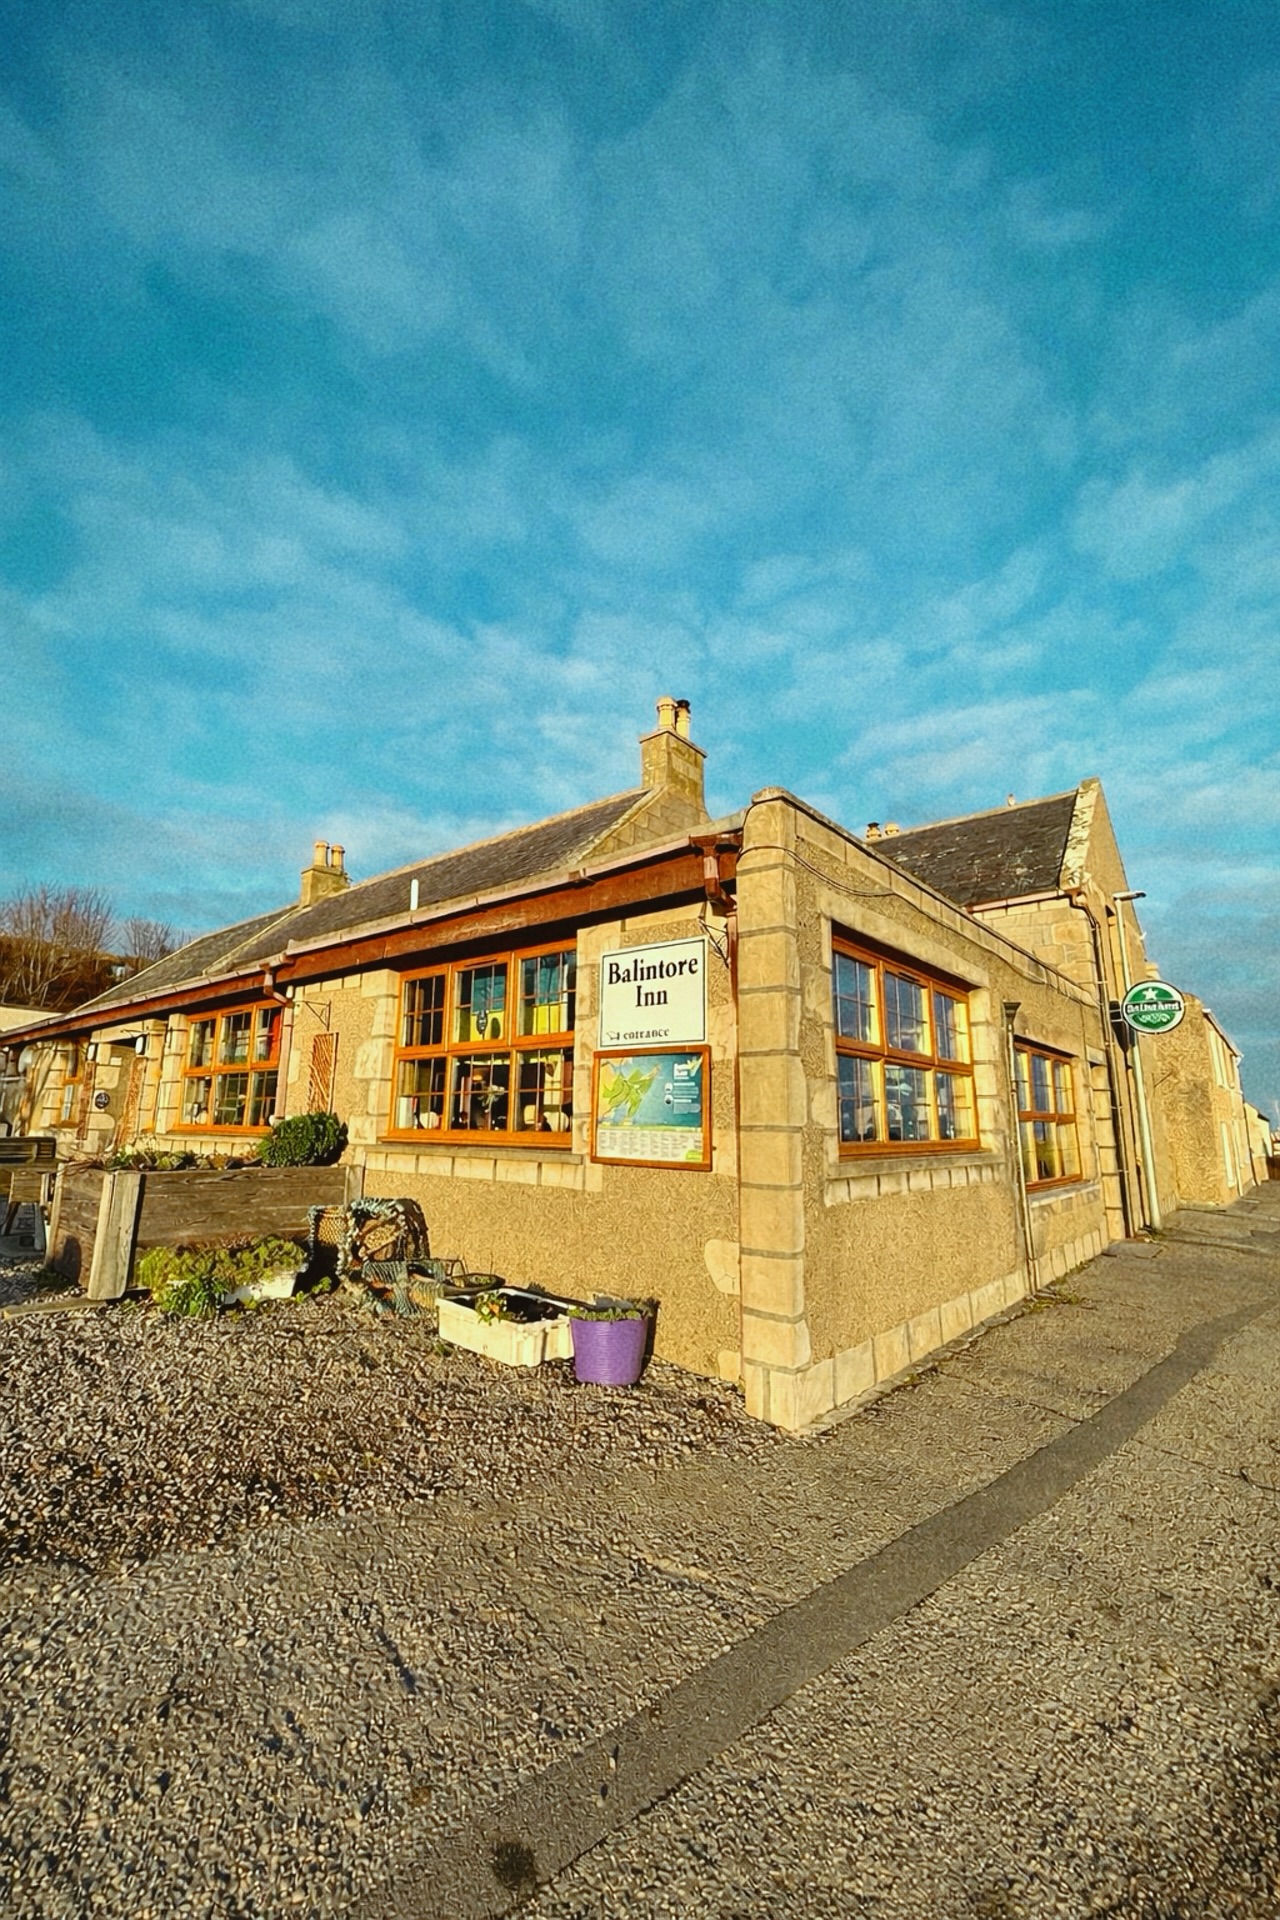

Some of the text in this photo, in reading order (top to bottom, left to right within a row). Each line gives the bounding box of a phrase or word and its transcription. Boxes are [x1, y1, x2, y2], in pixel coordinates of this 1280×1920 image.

[608, 957, 698, 985] Balintore
[635, 985, 668, 1008] Inn
[623, 1029, 670, 1040] entrance
